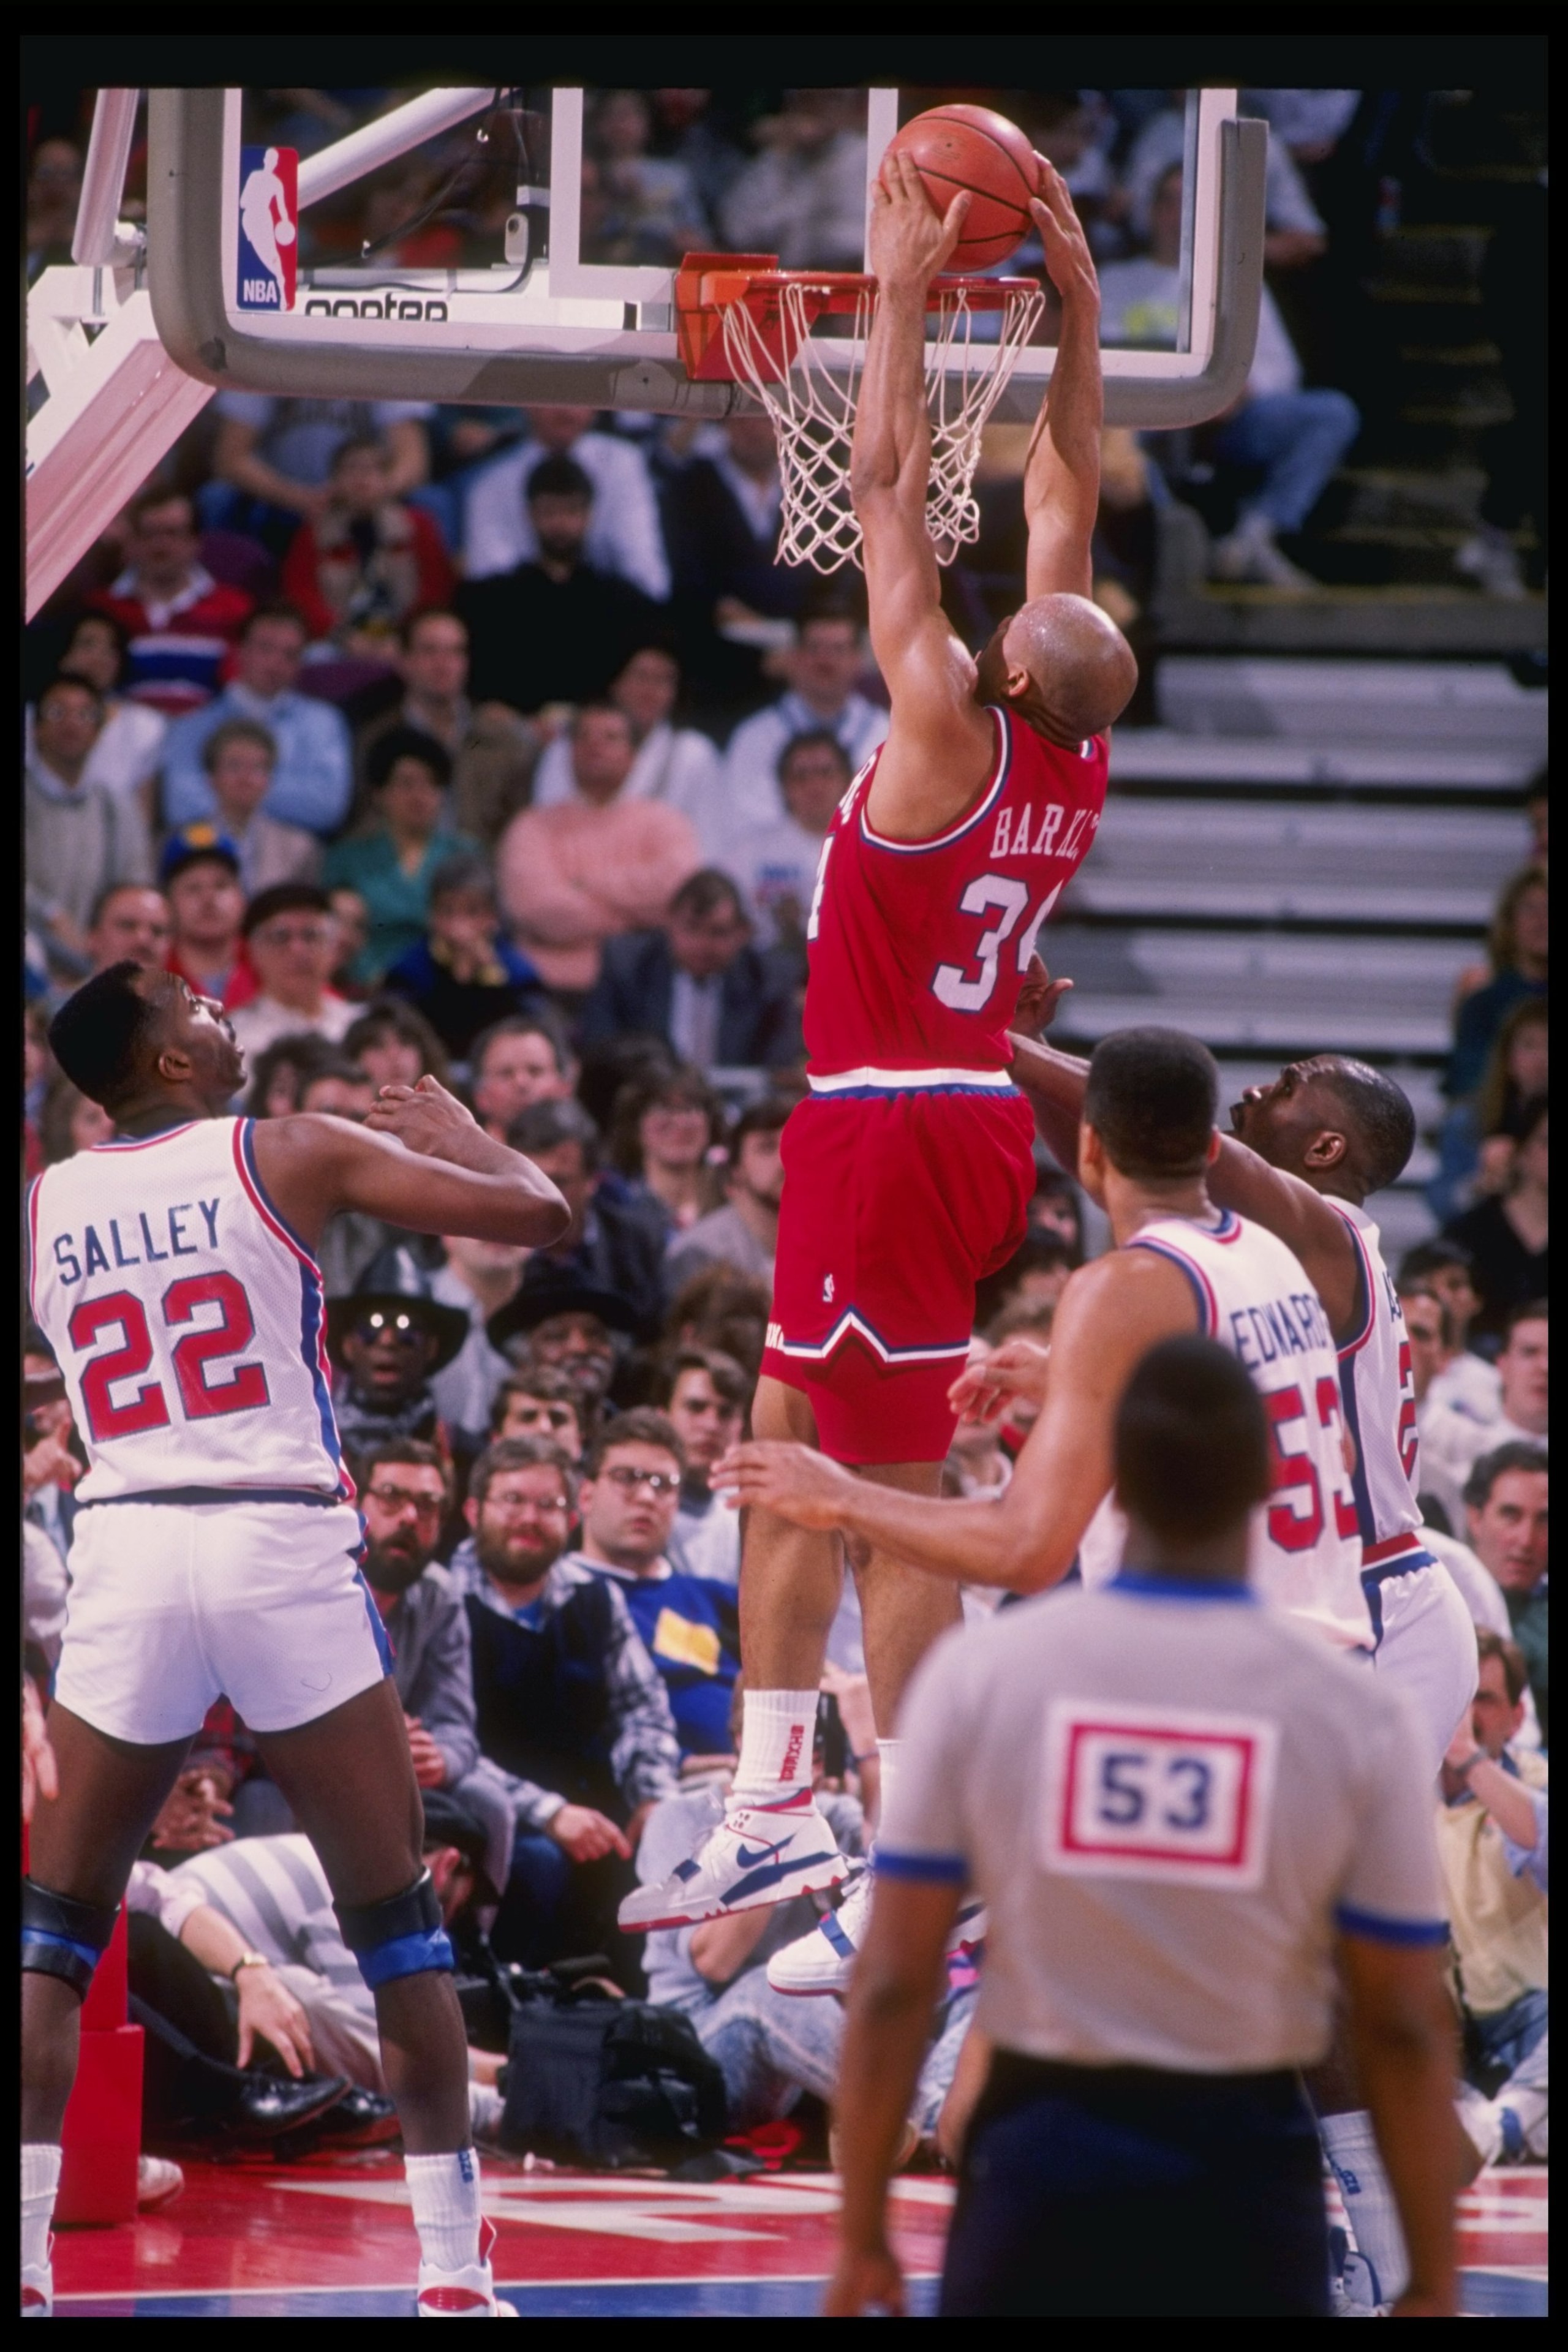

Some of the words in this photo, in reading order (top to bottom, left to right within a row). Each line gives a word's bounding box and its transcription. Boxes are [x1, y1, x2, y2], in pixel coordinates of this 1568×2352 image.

[243, 279, 277, 303] NBA
[53, 1198, 220, 1286] SALLEY
[67, 1270, 271, 1444] 22
[1100, 1753, 1209, 1830] 53
